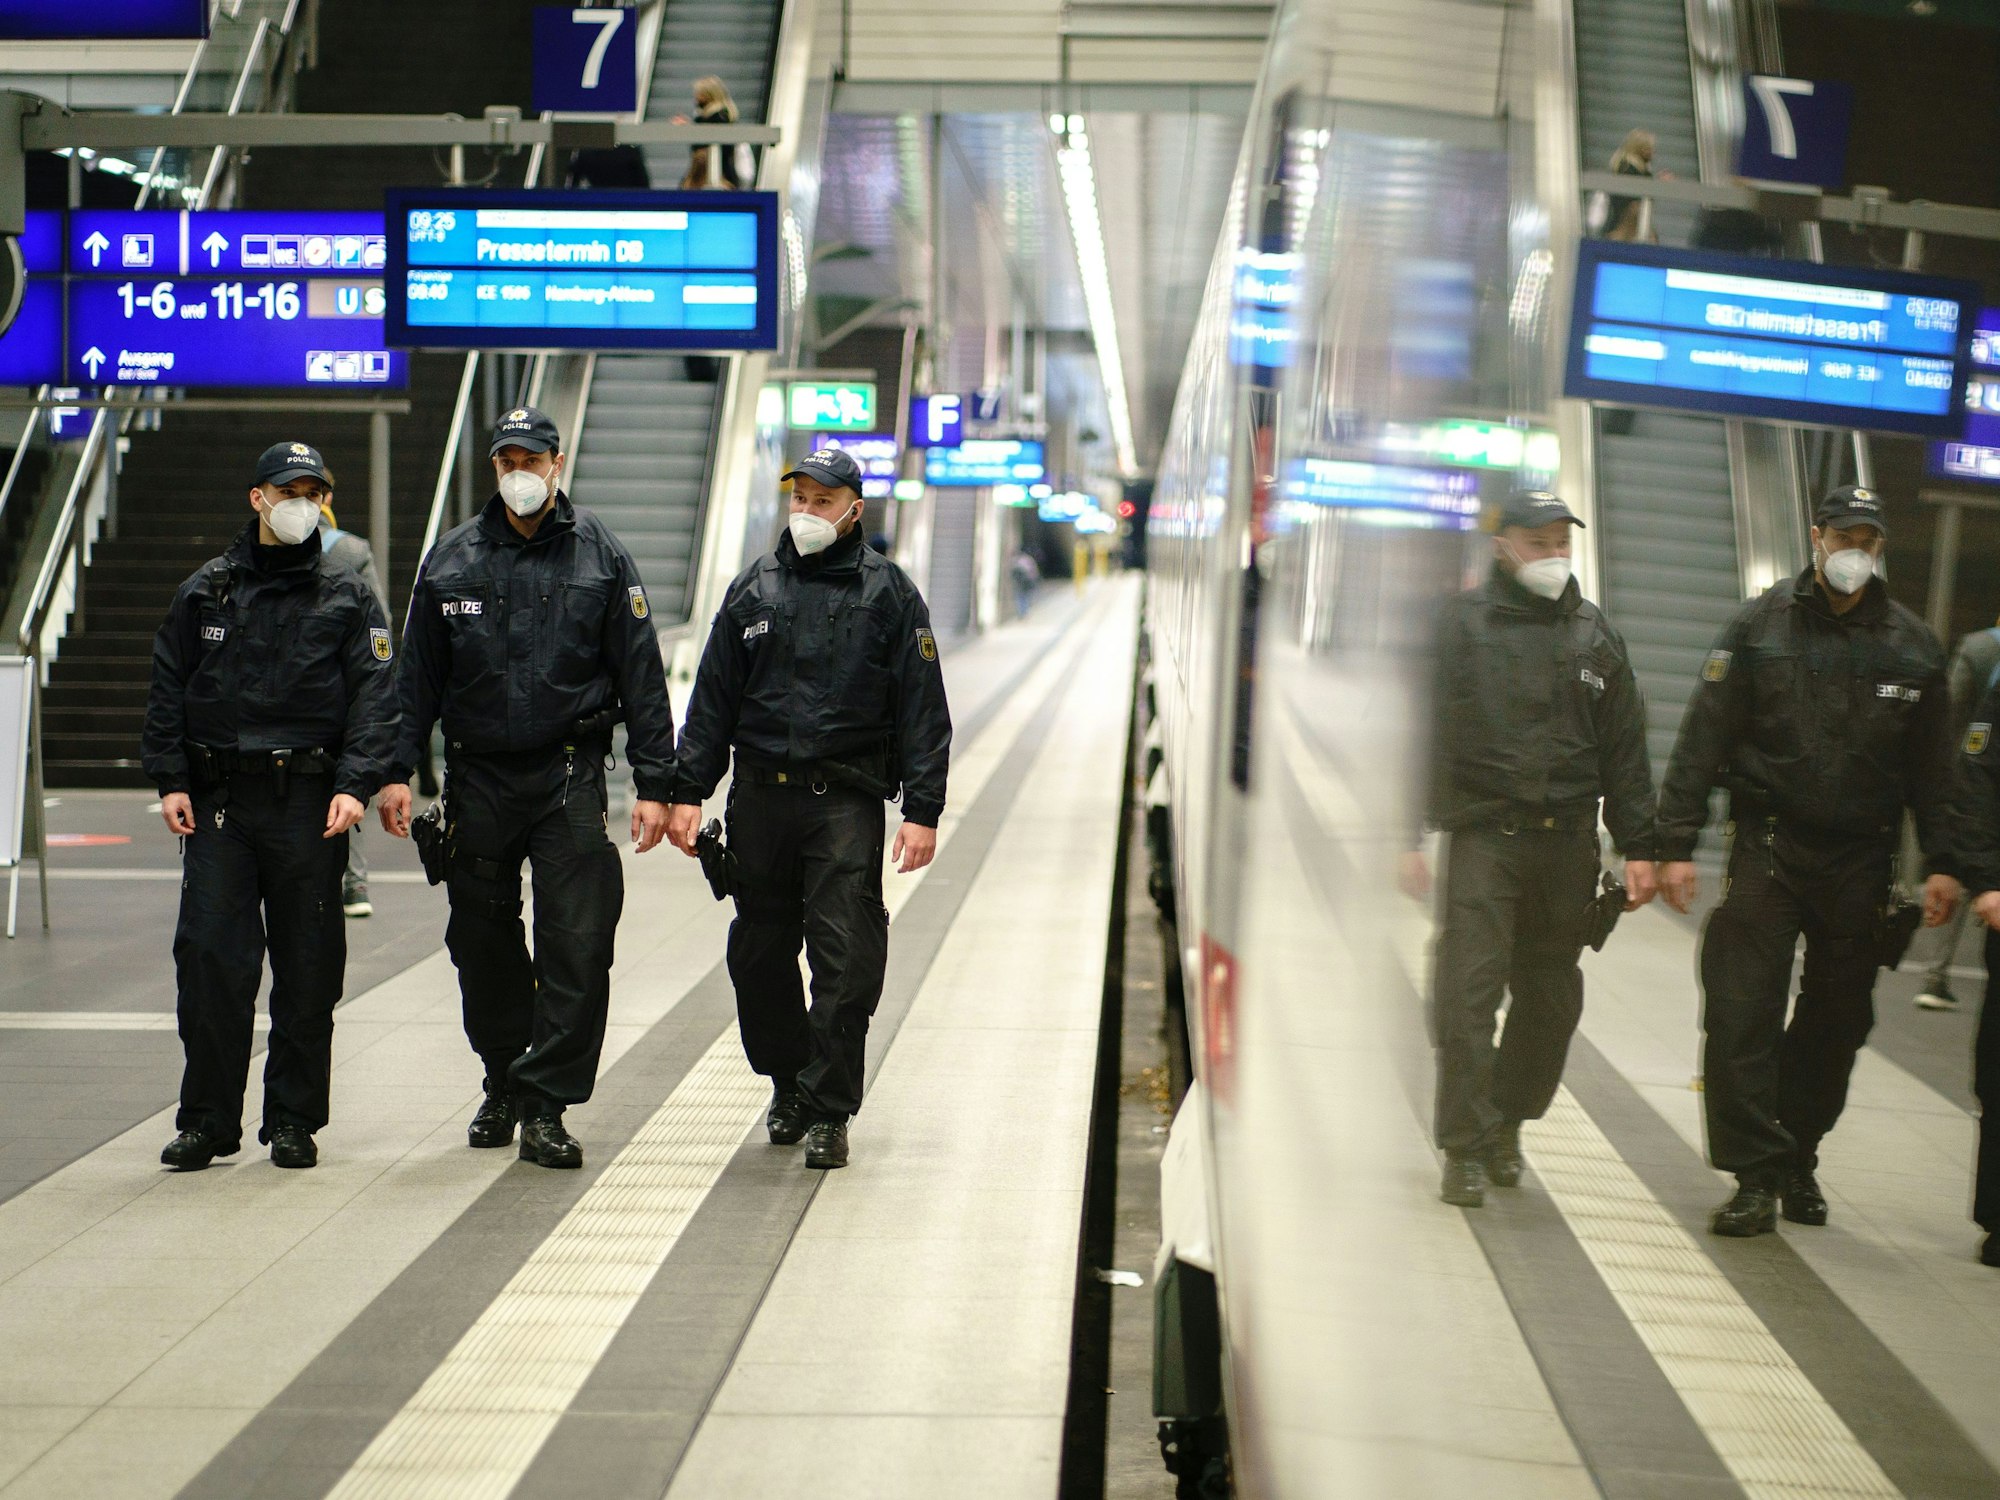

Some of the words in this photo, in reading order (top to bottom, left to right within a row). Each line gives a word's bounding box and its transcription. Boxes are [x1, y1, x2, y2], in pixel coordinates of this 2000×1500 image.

[572, 9, 625, 89] 7
[409, 211, 456, 231] 09:25
[476, 238, 610, 262] Pressetermin
[615, 240, 644, 262] DB
[117, 281, 176, 319] 1-6
[180, 302, 208, 319] und
[211, 282, 300, 320] 11-16
[338, 288, 359, 314] U
[364, 287, 386, 314] S
[117, 349, 174, 370] Ausgang
[502, 421, 531, 431] POLIZEI
[928, 394, 960, 442] F
[287, 456, 316, 466] POLIZEI
[803, 457, 832, 467] POLIZEI
